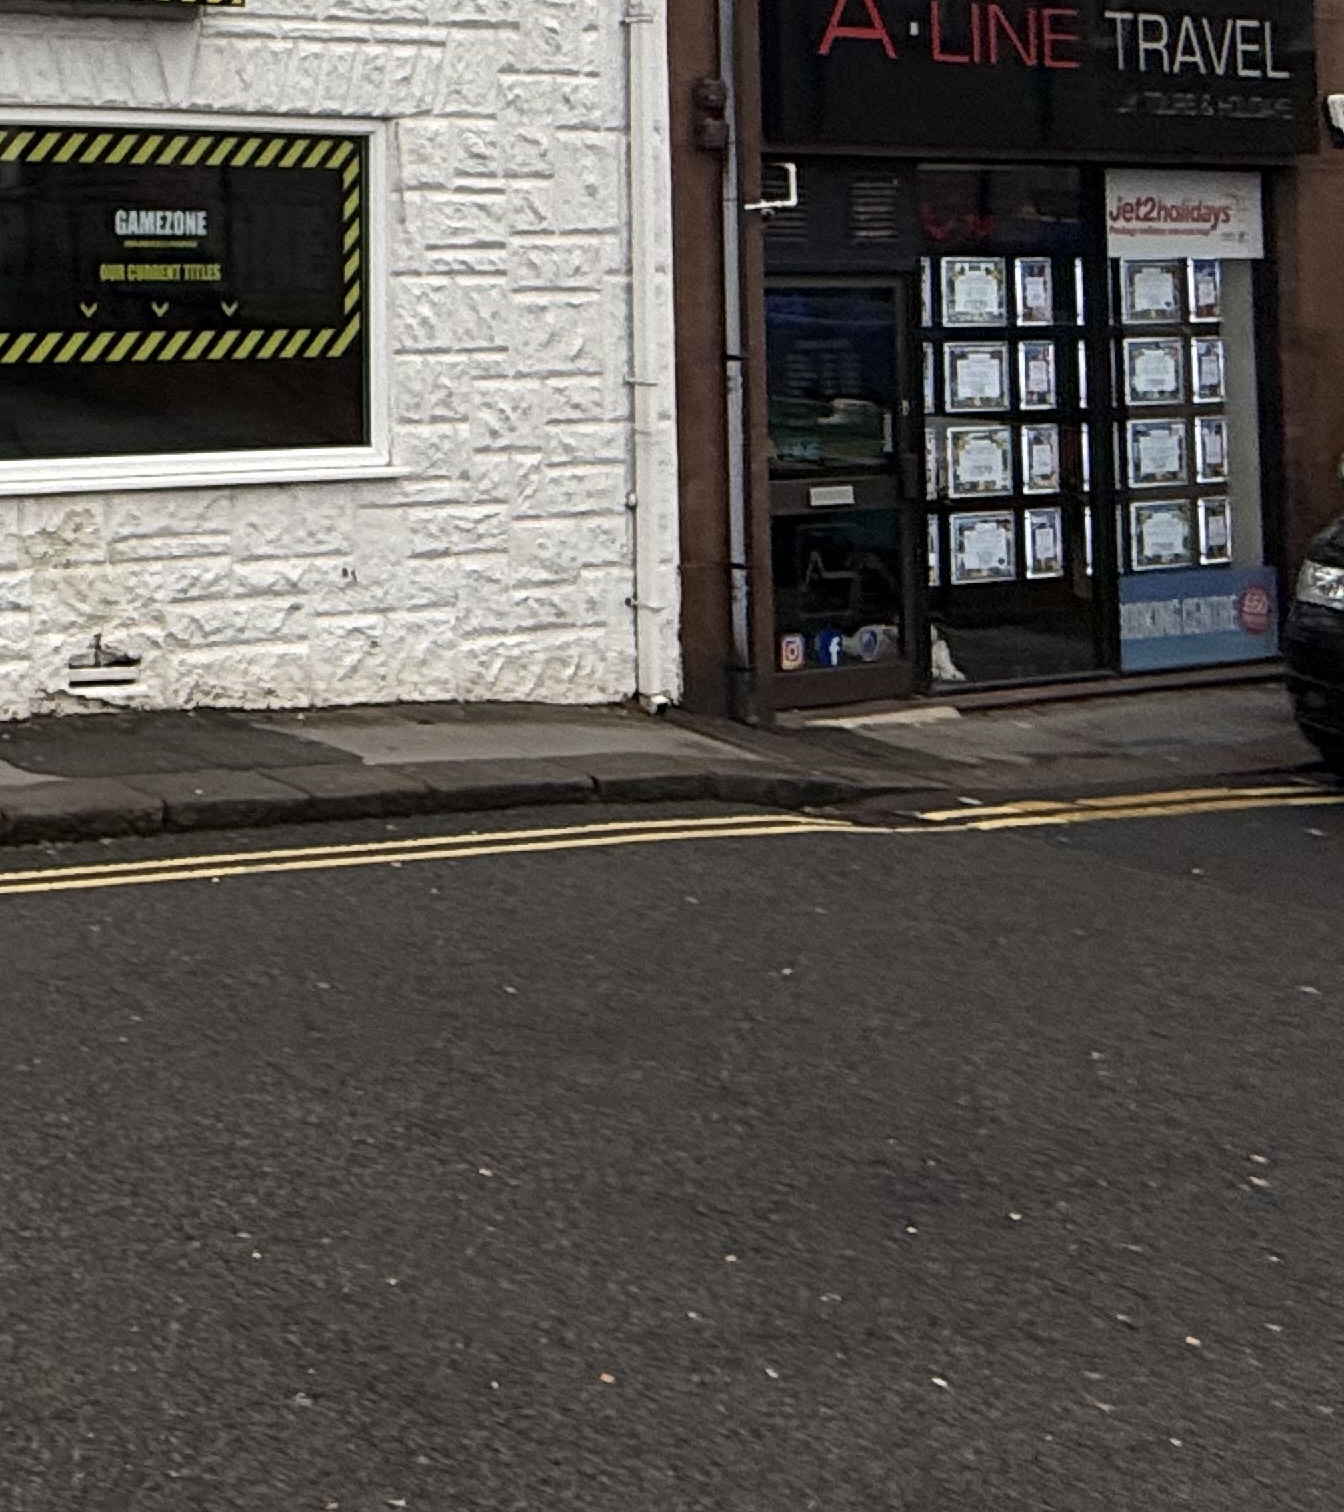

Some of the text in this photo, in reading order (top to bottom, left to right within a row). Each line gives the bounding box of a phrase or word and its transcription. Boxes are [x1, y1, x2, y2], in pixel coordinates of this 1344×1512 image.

[1104, 9, 1292, 80] TRAVEL
[114, 209, 208, 236] GAMEZONE
[182, 263, 222, 282] TITLES
